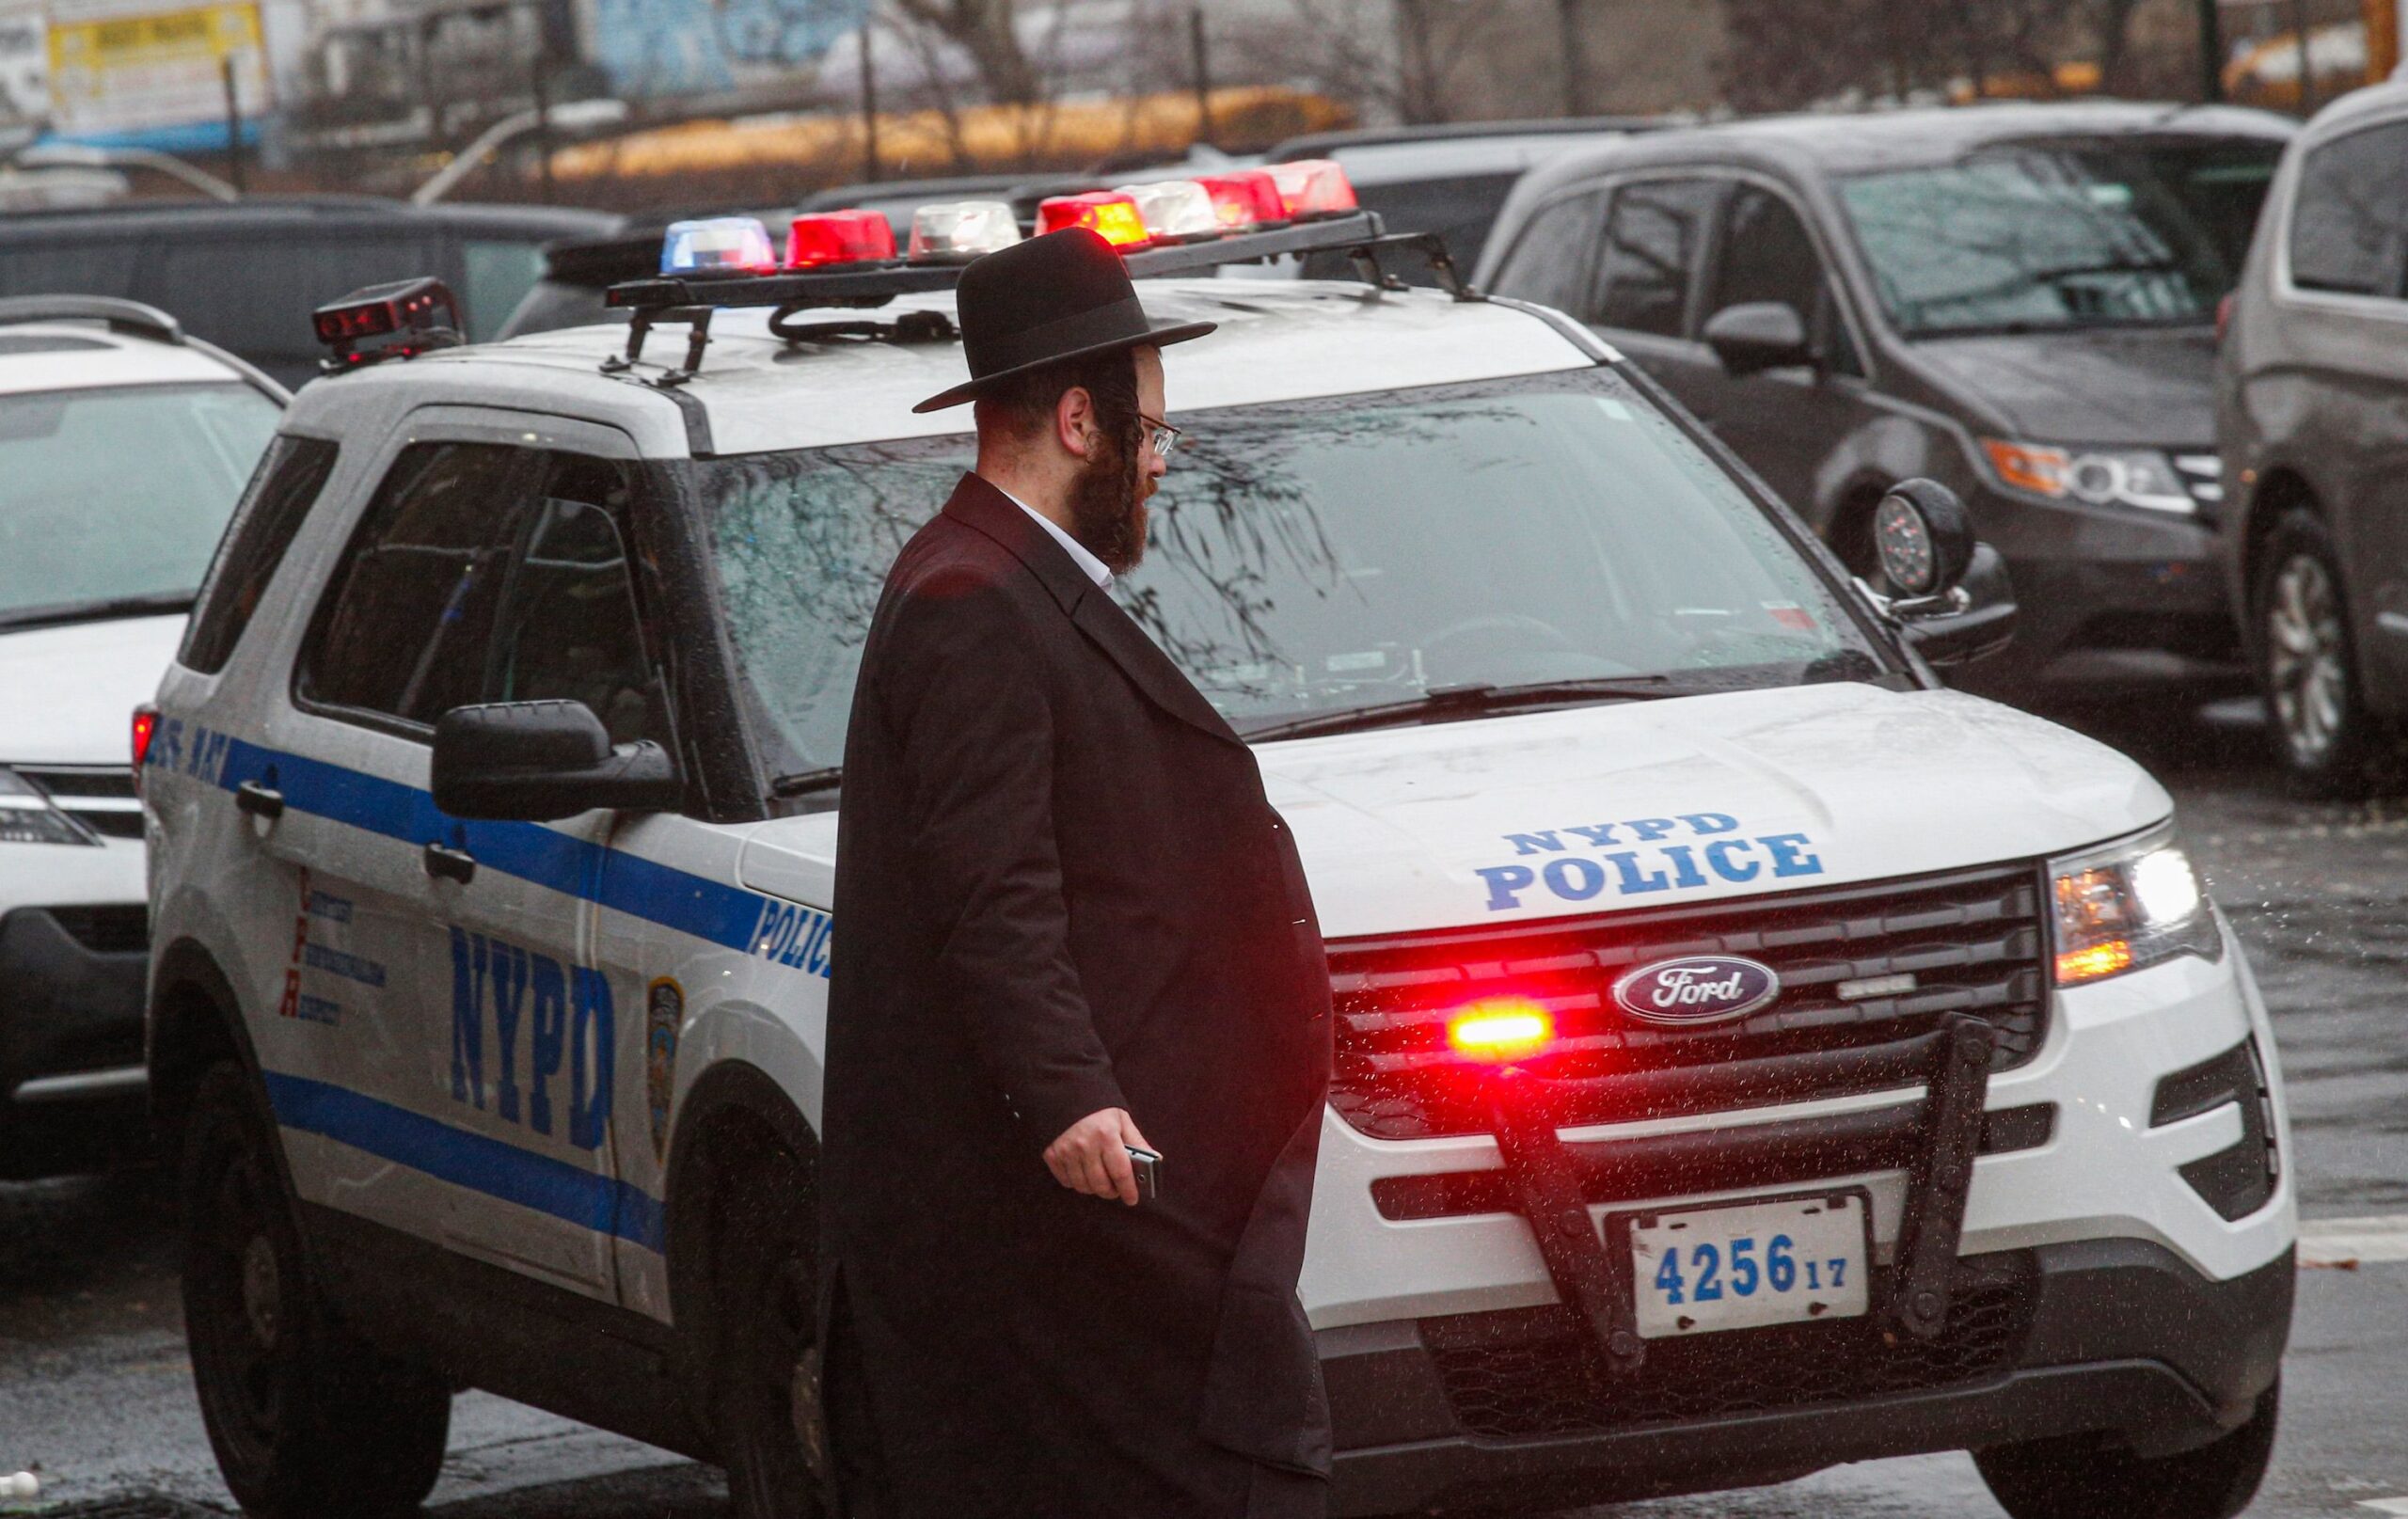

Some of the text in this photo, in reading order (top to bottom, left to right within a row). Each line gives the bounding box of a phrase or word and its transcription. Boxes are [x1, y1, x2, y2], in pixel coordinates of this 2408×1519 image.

[1475, 832, 1826, 911] POLICE
[1501, 812, 1739, 856] NYPD
[751, 898, 832, 979] POLIC
[1652, 966, 1745, 1007] Ford
[449, 924, 615, 1152] NYPD
[1655, 1233, 1846, 1305] 4256 17
